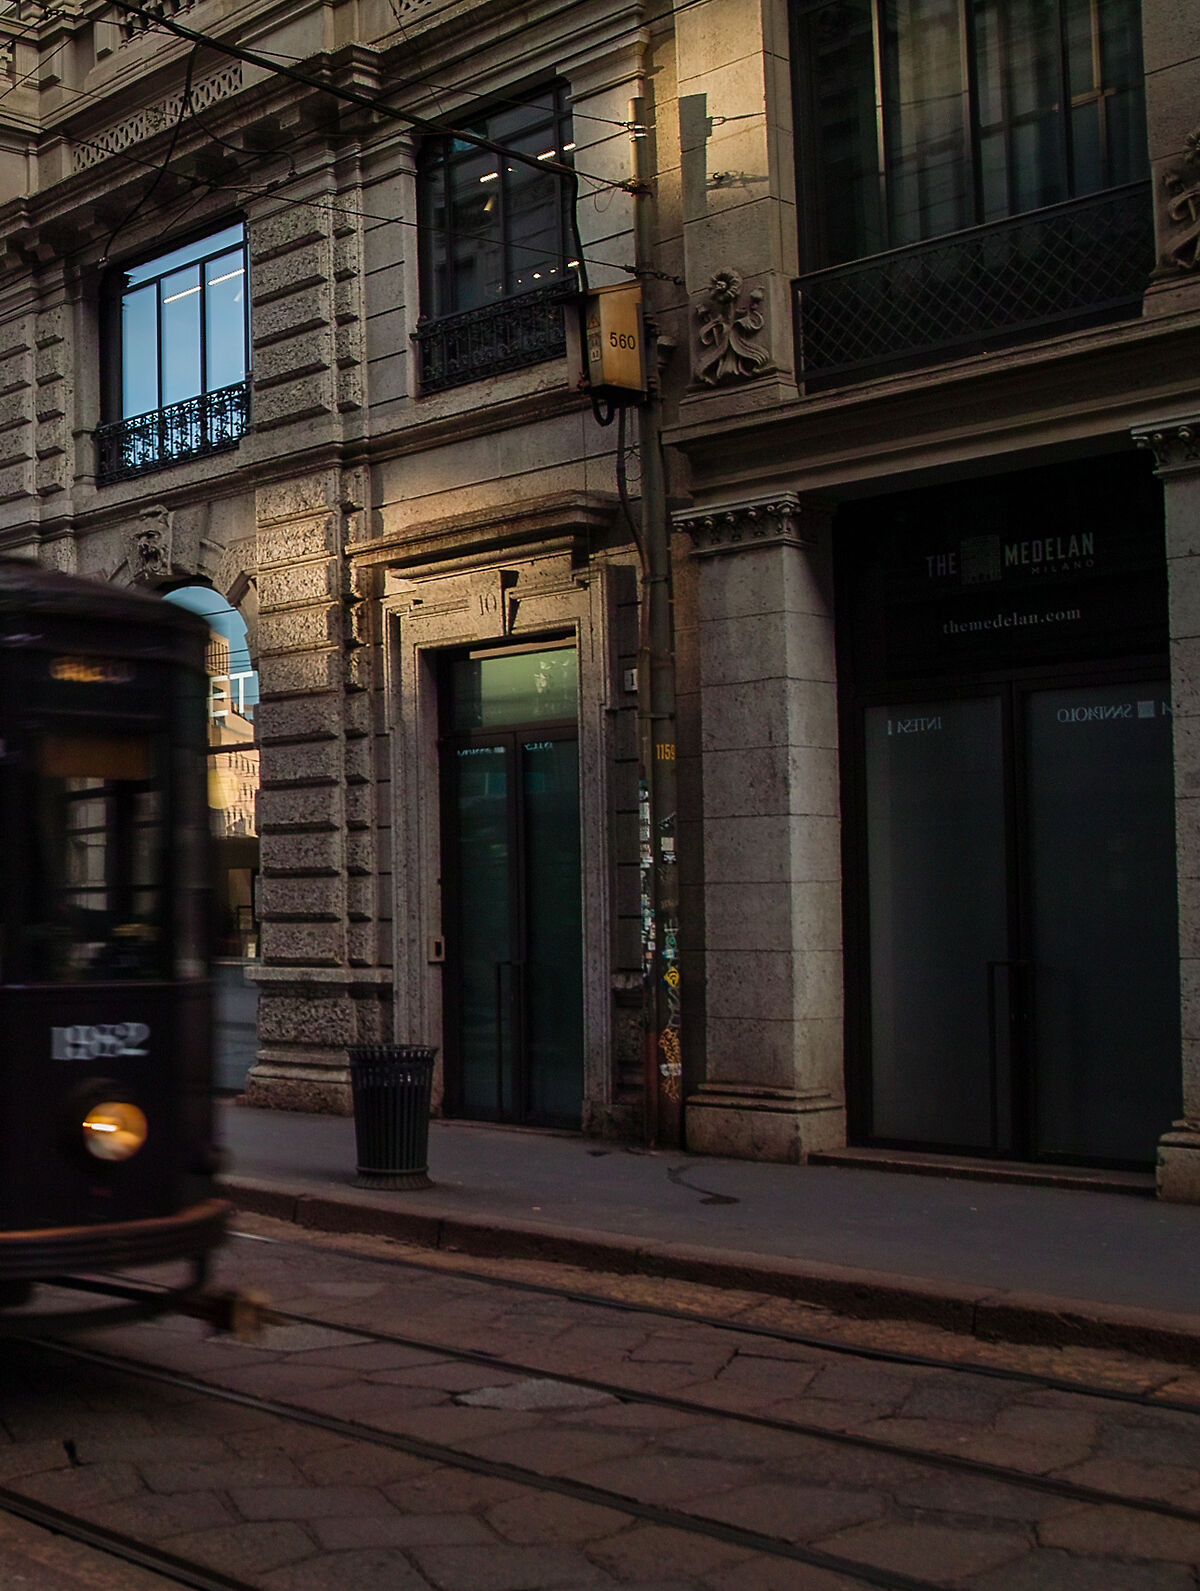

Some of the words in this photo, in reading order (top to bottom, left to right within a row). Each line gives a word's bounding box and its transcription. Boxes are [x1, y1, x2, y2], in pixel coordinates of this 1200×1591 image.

[610, 332, 636, 350] 560
[925, 552, 957, 578] THE
[1003, 531, 1095, 568] MEDELAN
[1031, 558, 1095, 576] MILANO
[943, 607, 1081, 635] themedelan.com
